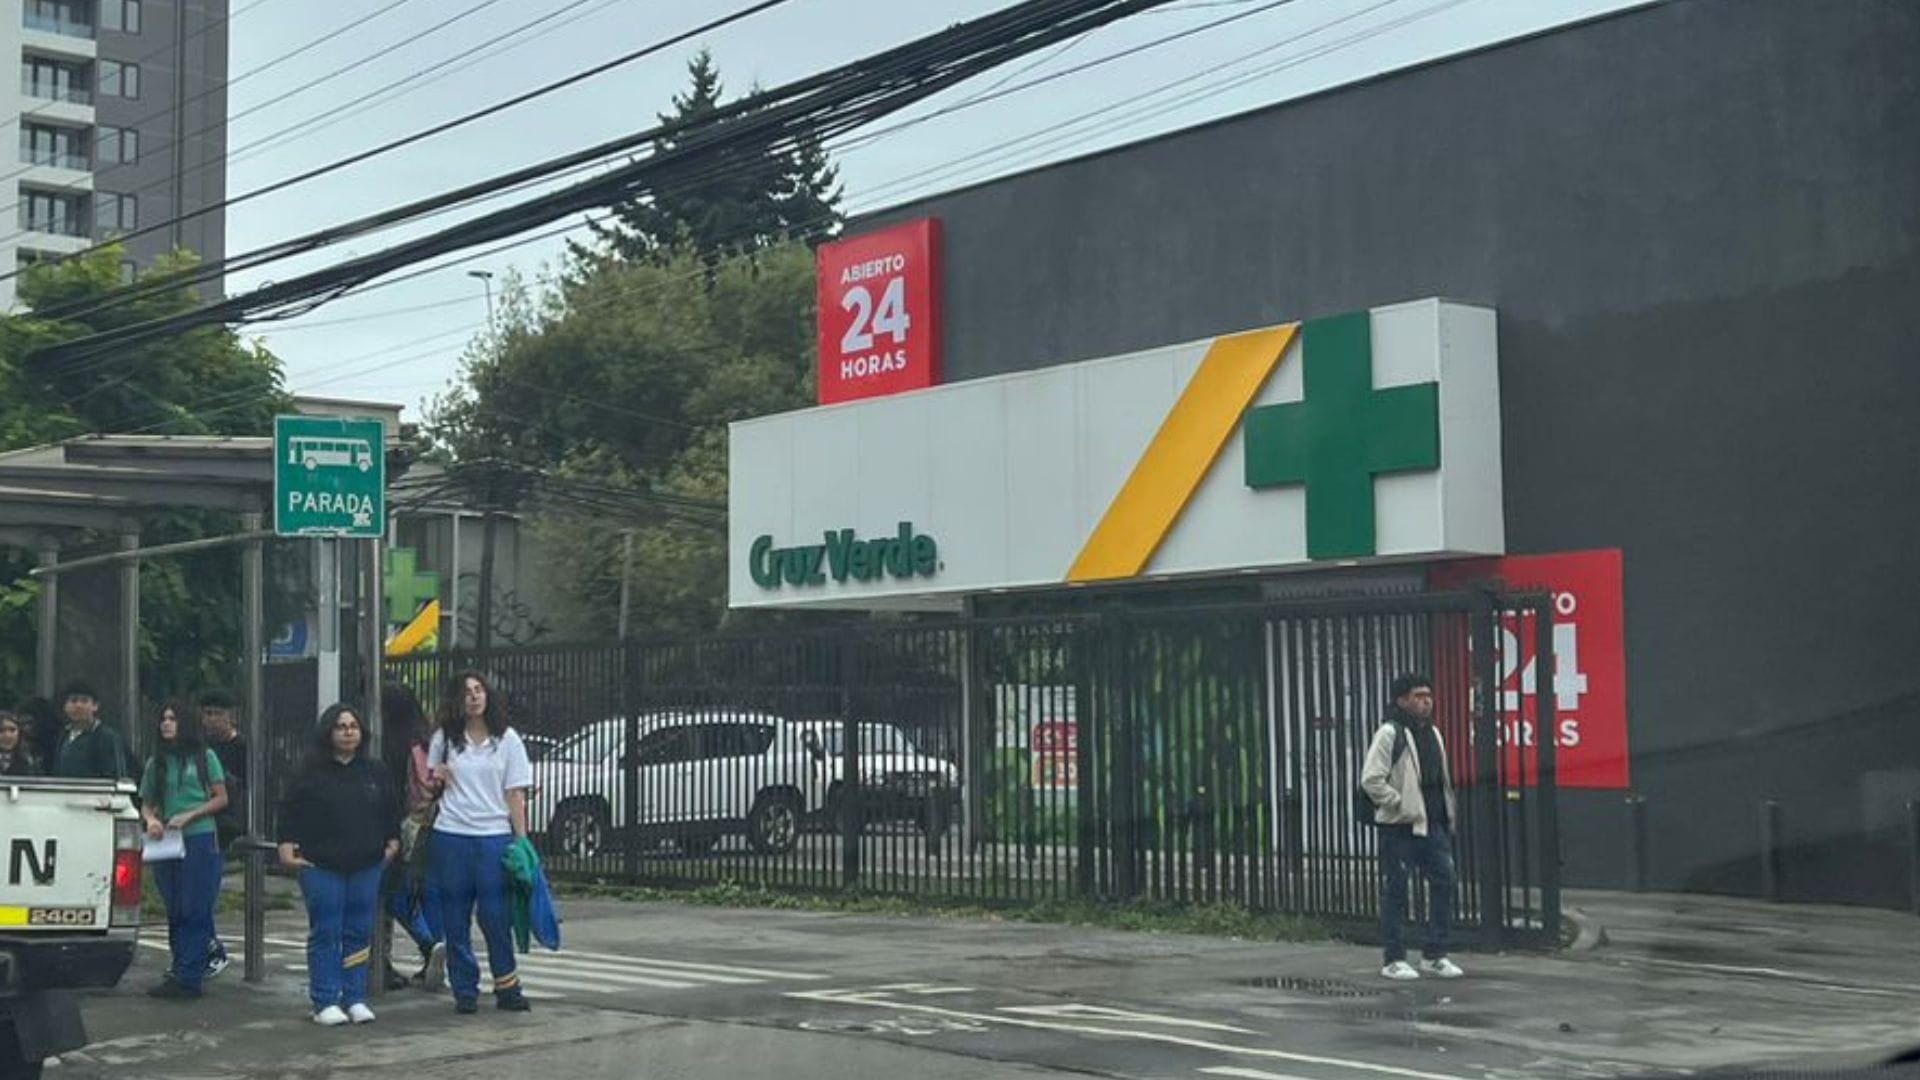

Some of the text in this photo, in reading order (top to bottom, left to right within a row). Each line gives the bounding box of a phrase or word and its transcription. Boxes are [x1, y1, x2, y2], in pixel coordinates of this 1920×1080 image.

[841, 254, 905, 284] ABIERTO
[841, 276, 911, 353] 24
[841, 350, 907, 379] HORAS
[288, 491, 374, 514] PARADA
[750, 535, 826, 588] Cruz
[9, 838, 58, 886] N
[31, 909, 94, 924] 2400
